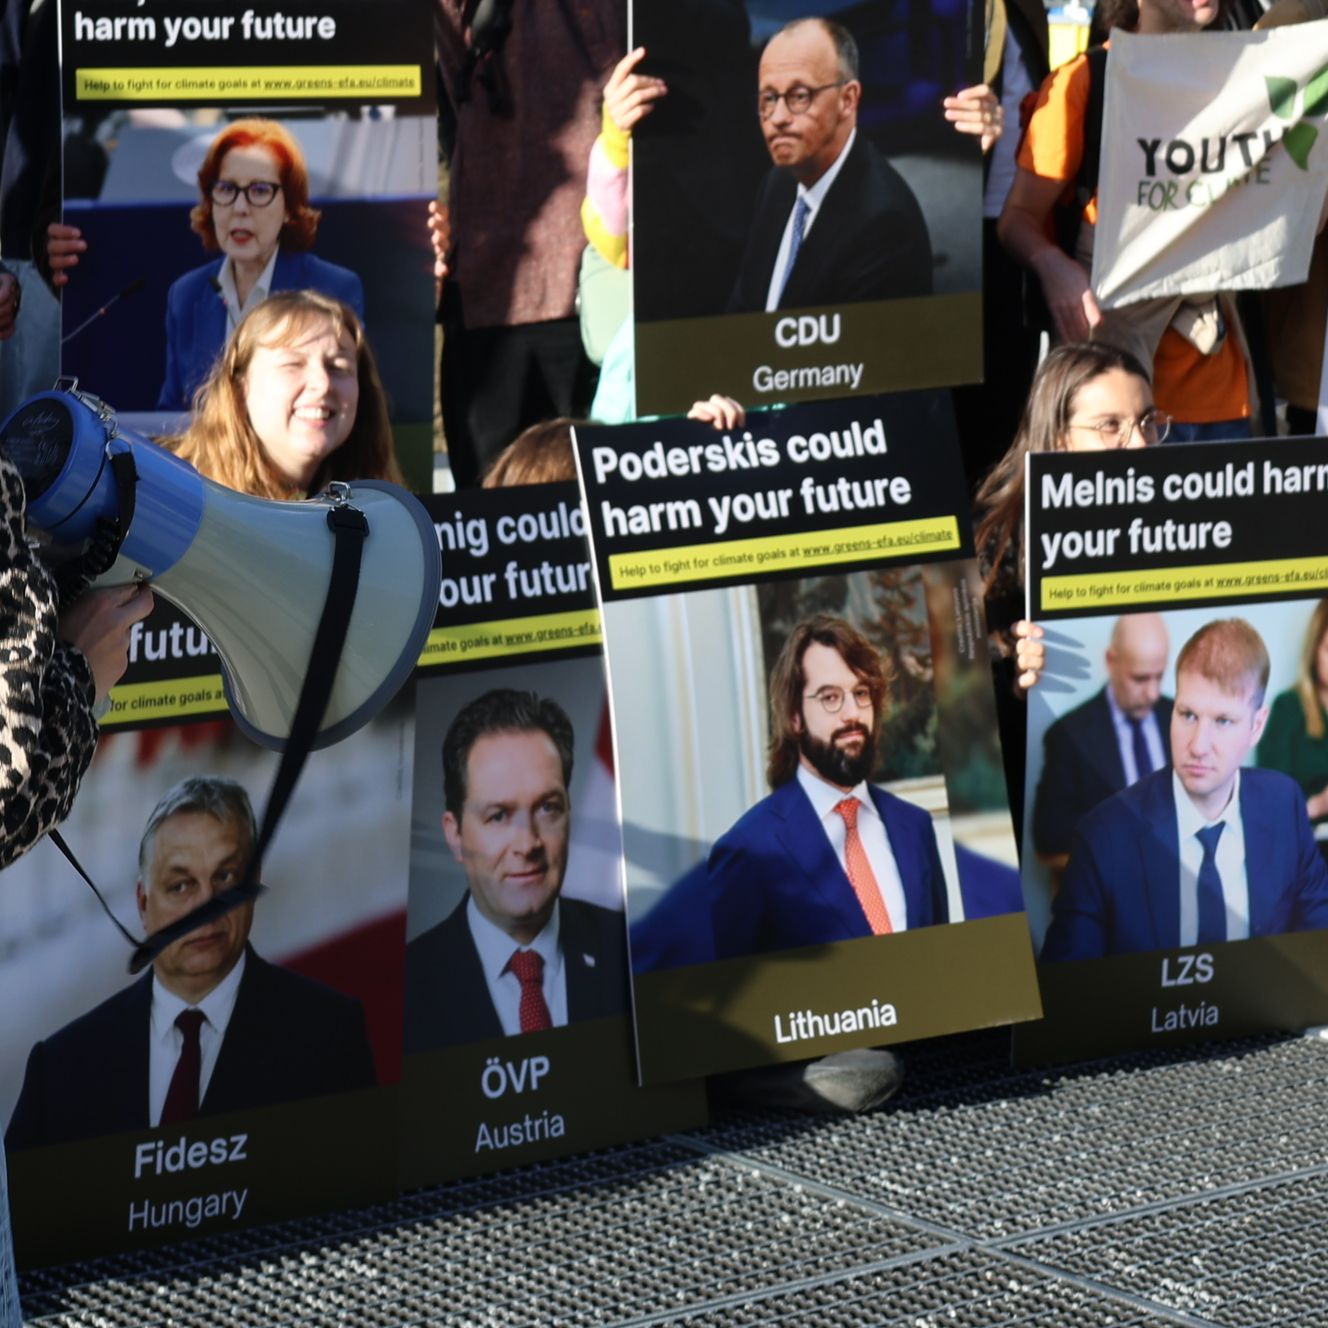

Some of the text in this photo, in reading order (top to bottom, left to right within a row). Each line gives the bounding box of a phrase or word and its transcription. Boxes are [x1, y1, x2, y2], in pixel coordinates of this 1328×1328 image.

[74, 9, 336, 47] harm your future
[1137, 180, 1181, 212] FOR
[774, 313, 841, 348] CDU
[752, 363, 864, 393] Germany
[592, 418, 887, 484] Poderskis could
[1041, 467, 1155, 509] Melnis
[1162, 461, 1255, 501] could
[601, 476, 912, 538] harm your future
[619, 563, 648, 579] Help
[649, 562, 662, 574] to
[662, 559, 691, 575] fight
[692, 557, 709, 569] for
[712, 553, 755, 567] climate
[756, 548, 787, 565] goals
[789, 546, 801, 558] at
[1161, 952, 1214, 987] LZS
[774, 999, 897, 1044] Lithuania
[1151, 1000, 1219, 1033] Latvia
[481, 1055, 550, 1099] ÖVP
[474, 1110, 565, 1153] Austria
[134, 1133, 248, 1179] Fidesz
[128, 1188, 248, 1232] Hungary
